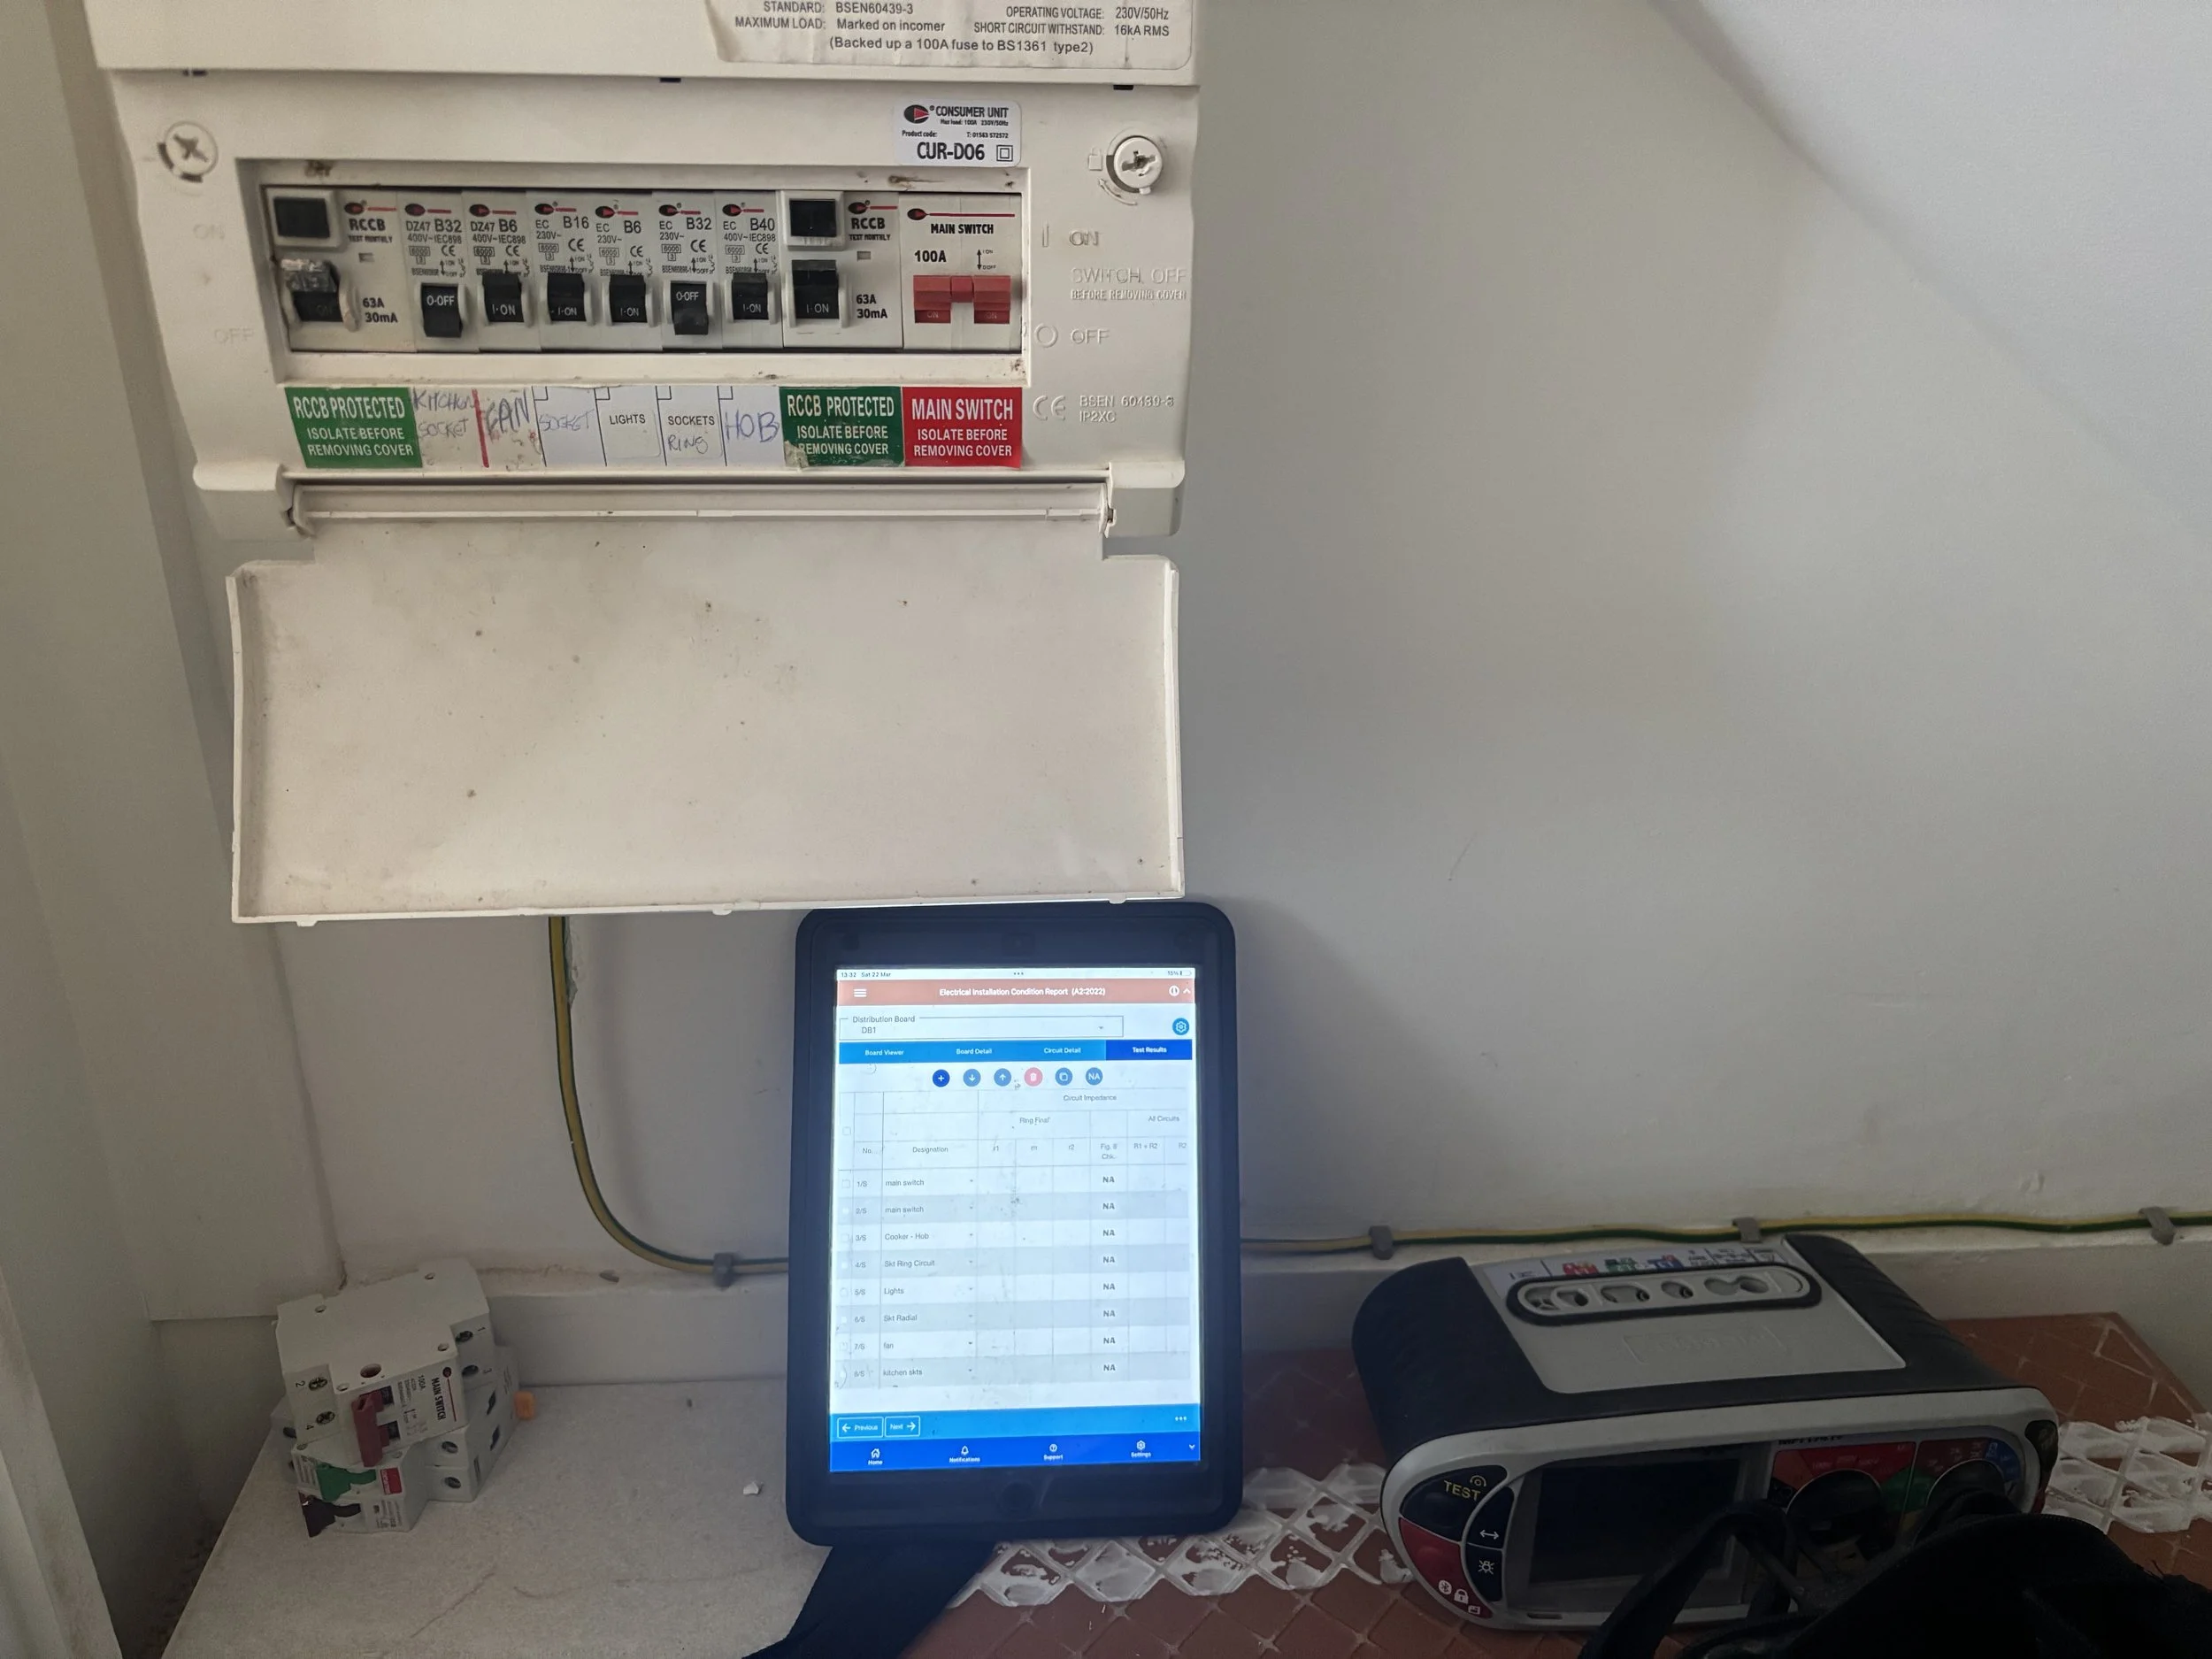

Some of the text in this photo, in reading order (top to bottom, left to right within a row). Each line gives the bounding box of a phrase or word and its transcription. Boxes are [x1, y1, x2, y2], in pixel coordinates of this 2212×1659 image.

[764, 0, 914, 14] STANDARD: BSEN60439-3
[1006, 7, 1169, 20] OPERATING VOLTAGE: 230V/50Hz
[735, 17, 945, 32] MAXIMUM LOAD: Marked on incomer
[973, 22, 1170, 36] SHORT CIRCUIT WITHSTAND: 16kA RMS
[829, 36, 1094, 55] (Backed up a 100A fuse to BS1361 type2)
[935, 105, 1010, 118] CONSUMER UNIT
[349, 218, 386, 232] RCCB
[406, 219, 462, 234] DZ47 B32
[471, 219, 518, 234] DZ47 B6
[535, 216, 589, 229] EC B16
[595, 220, 641, 234] EC B6
[659, 217, 712, 231] EC B32
[723, 218, 776, 232] EC B40
[851, 218, 886, 230] RCCB
[931, 223, 995, 235] MAIN SWITCH
[1069, 230, 1100, 247] ON
[914, 250, 948, 264] 100A
[1071, 267, 1187, 284] SWITCH OFF
[856, 294, 877, 305] 63A
[1071, 289, 1187, 301] BEFORE REMOVING COVER
[362, 297, 385, 309] 63A
[365, 311, 398, 324] 30mA
[856, 308, 888, 319] 30mA
[1070, 328, 1110, 344] OFF
[293, 396, 406, 419] RCCB PROTECTED
[787, 395, 895, 418] RCCB PROTECTED
[911, 398, 1013, 420] MAIN SWITCH
[1079, 396, 1115, 408] BSEN
[483, 389, 531, 437] FAN
[610, 414, 646, 426] LIGHTS
[668, 415, 715, 426] SOCKETS
[724, 410, 780, 442] HOB
[307, 427, 405, 441] ISOLATE BEFORE
[796, 425, 889, 439] ISOLATE BEFORE
[918, 428, 1008, 441] ISOLATE BEFORE
[307, 443, 414, 457] REMOVING COVER
[667, 435, 709, 455] RING
[798, 442, 889, 456] REMOVING COVER
[913, 445, 1012, 457] REMOVING COVER
[939, 987, 972, 996] Electrical
[972, 987, 1010, 996] Installation
[1045, 987, 1068, 996] Report
[432, 1377, 447, 1421] MAIN SWITCH
[1443, 1480, 1481, 1502] TEST
